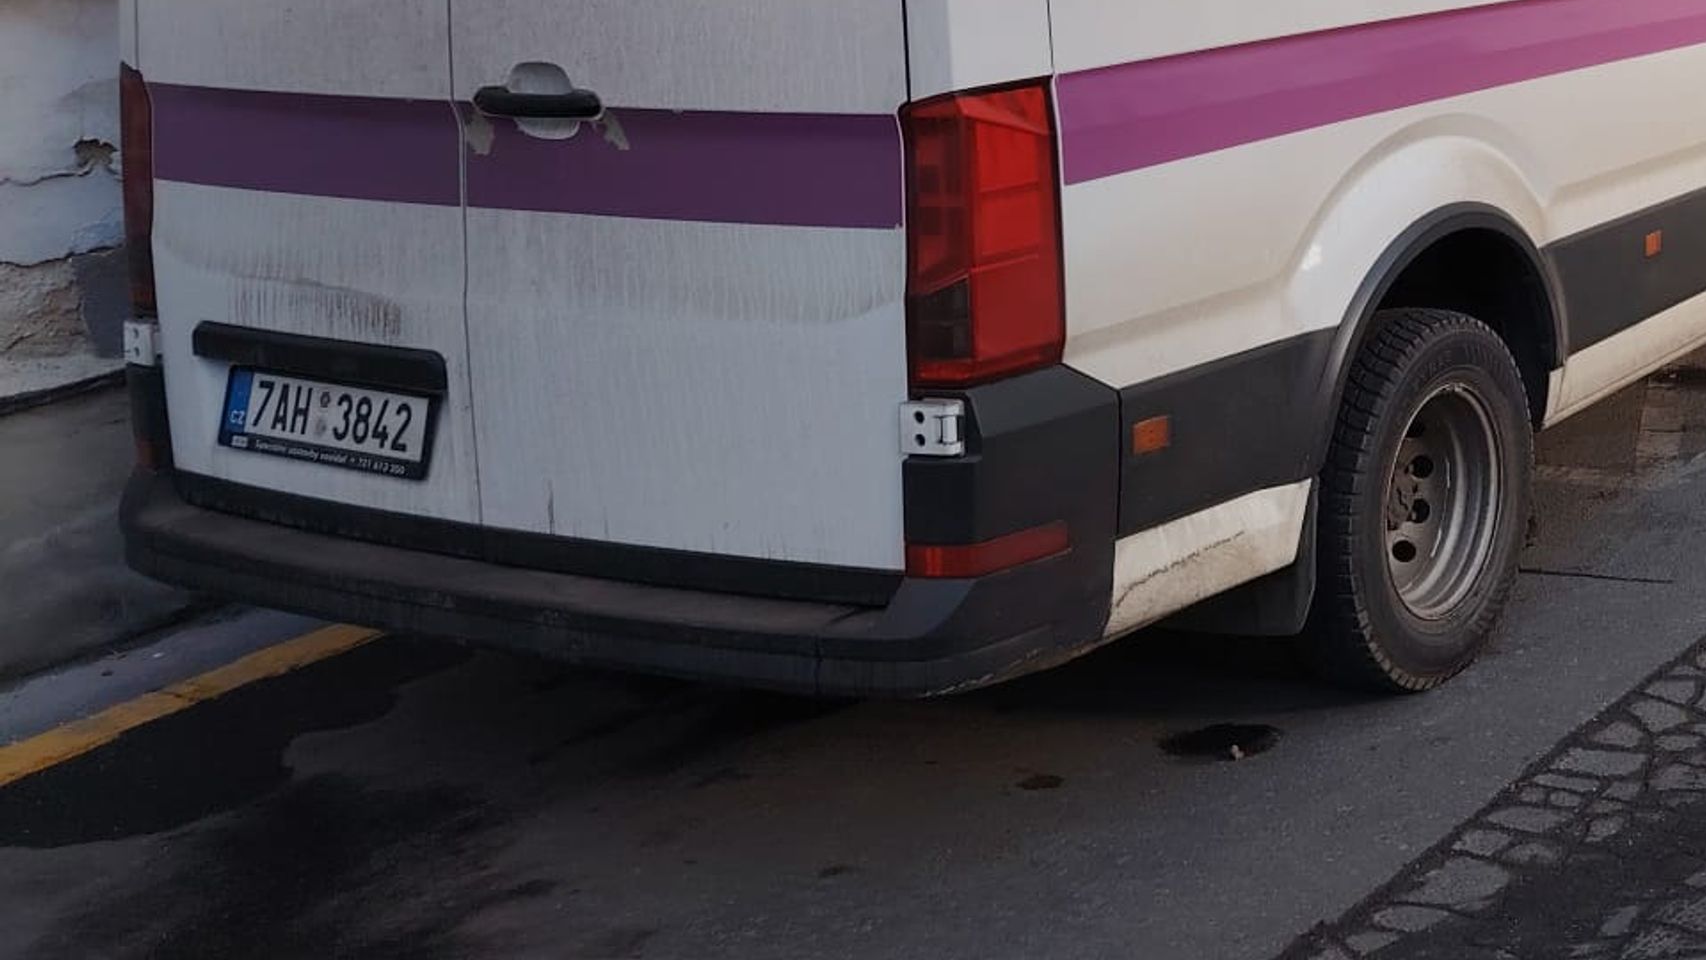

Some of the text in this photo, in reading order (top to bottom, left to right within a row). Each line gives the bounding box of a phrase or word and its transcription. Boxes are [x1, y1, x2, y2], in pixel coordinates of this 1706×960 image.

[230, 409, 246, 425] CZ
[252, 381, 313, 436] 7AH
[332, 393, 412, 452] 3842
